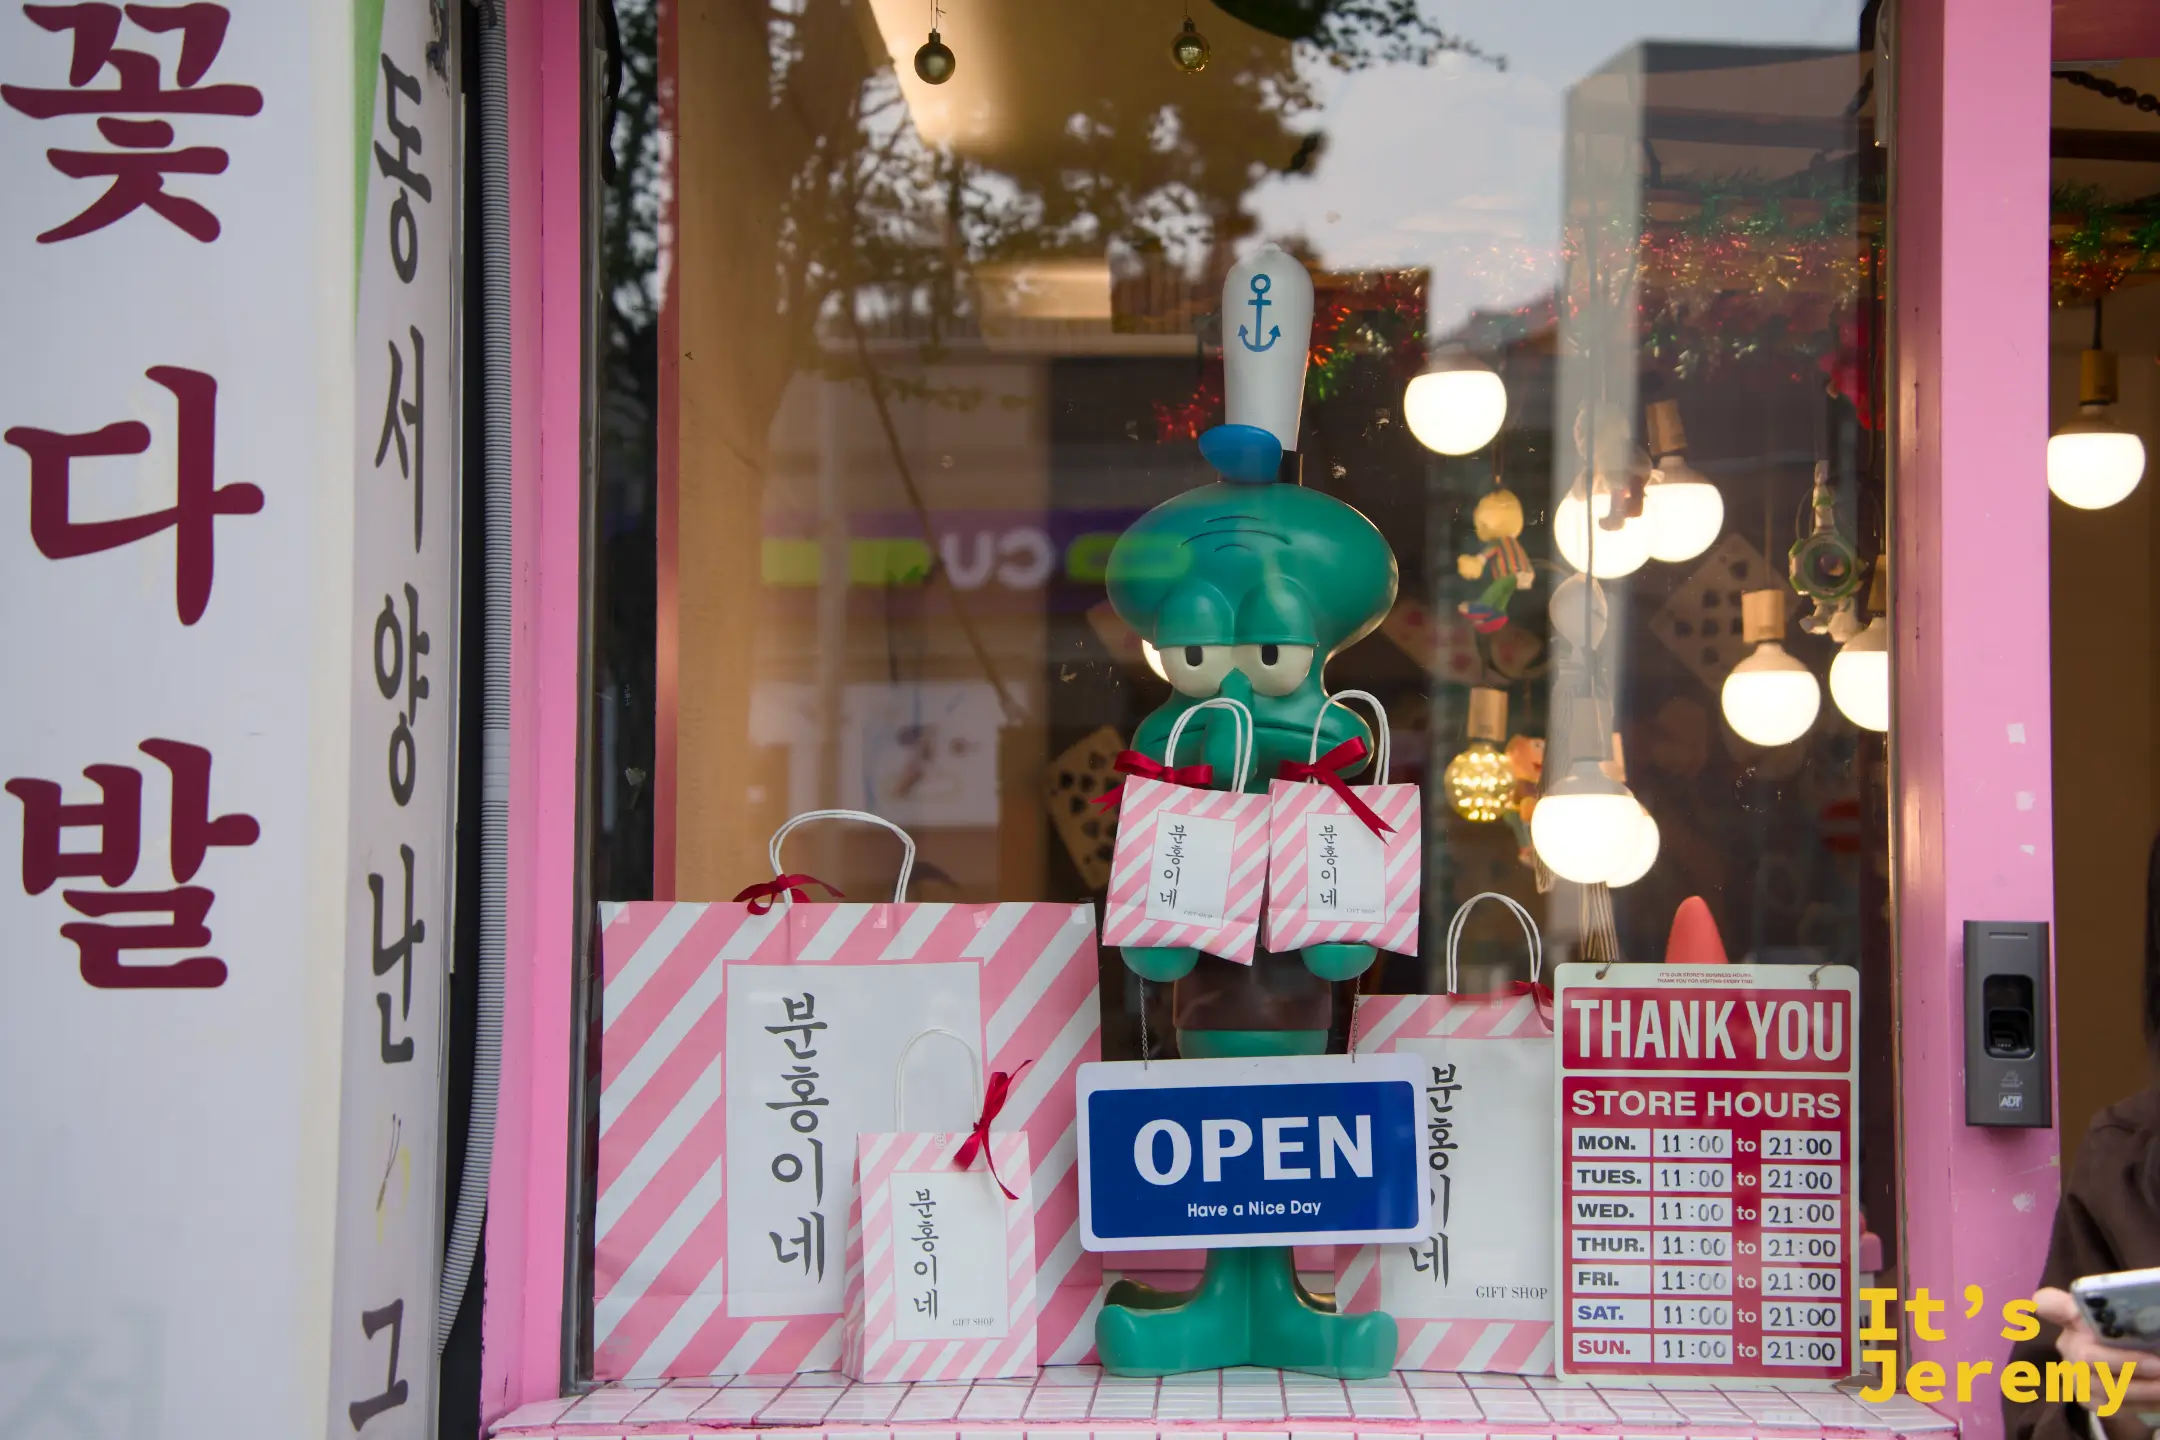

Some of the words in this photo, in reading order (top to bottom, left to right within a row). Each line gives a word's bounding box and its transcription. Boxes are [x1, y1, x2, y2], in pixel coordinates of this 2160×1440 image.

[0, 3, 265, 989] 꽃다발
[368, 51, 433, 1065] 동서양난
[1159, 824, 1188, 910] 분홍이네
[1318, 824, 1339, 910] 분홍이네
[1571, 999, 1736, 1059] THANK
[1745, 1000, 1843, 1061] YOU
[1571, 1090, 1697, 1117] STORE
[1707, 1091, 1841, 1119] HOURS
[2000, 1095, 2022, 1108] ADT
[764, 992, 830, 1284] 분홍이네
[1578, 1135, 1636, 1151] MON.
[1662, 1134, 1724, 1153] 11:00
[1736, 1137, 1757, 1153] to
[1768, 1137, 1833, 1156] 21:00
[1133, 1114, 1374, 1186] OPEN
[1577, 1169, 1642, 1185] TUES.
[1661, 1168, 1724, 1188] 11:00
[1736, 1172, 1757, 1187] to
[1768, 1169, 1833, 1190] 21:00
[1187, 1202, 1228, 1218] Have
[1233, 1204, 1244, 1217] a
[1248, 1201, 1285, 1216] Nice
[1290, 1200, 1322, 1216] Day
[1577, 1203, 1635, 1218] WED.
[1661, 1202, 1724, 1222] 11:00
[1736, 1206, 1757, 1221] to
[1768, 1204, 1835, 1224] 21:00
[908, 1187, 940, 1321] 분홍이네
[1577, 1237, 1645, 1253] THUR.
[1662, 1236, 1726, 1256] 11:00
[1736, 1240, 1757, 1255] to
[1768, 1239, 1837, 1258] 21:00
[1578, 1271, 1619, 1287] FRI.
[1661, 1270, 1727, 1291] 11:00
[1736, 1274, 1757, 1289] to
[1768, 1272, 1837, 1292] 21:00
[1475, 1286, 1508, 1299] GIFT
[1511, 1286, 1548, 1300] SHOP
[952, 1317, 971, 1327] GIFT
[972, 1317, 995, 1326] SHOP
[1577, 1305, 1624, 1321] SAT.
[1663, 1305, 1728, 1326] 11:00
[1736, 1309, 1757, 1323] to
[1769, 1307, 1837, 1327] 21:00
[1577, 1340, 1631, 1355] SUN.
[1663, 1339, 1727, 1359] 11:00
[1736, 1343, 1757, 1358] to
[1767, 1341, 1836, 1361] 21:00
